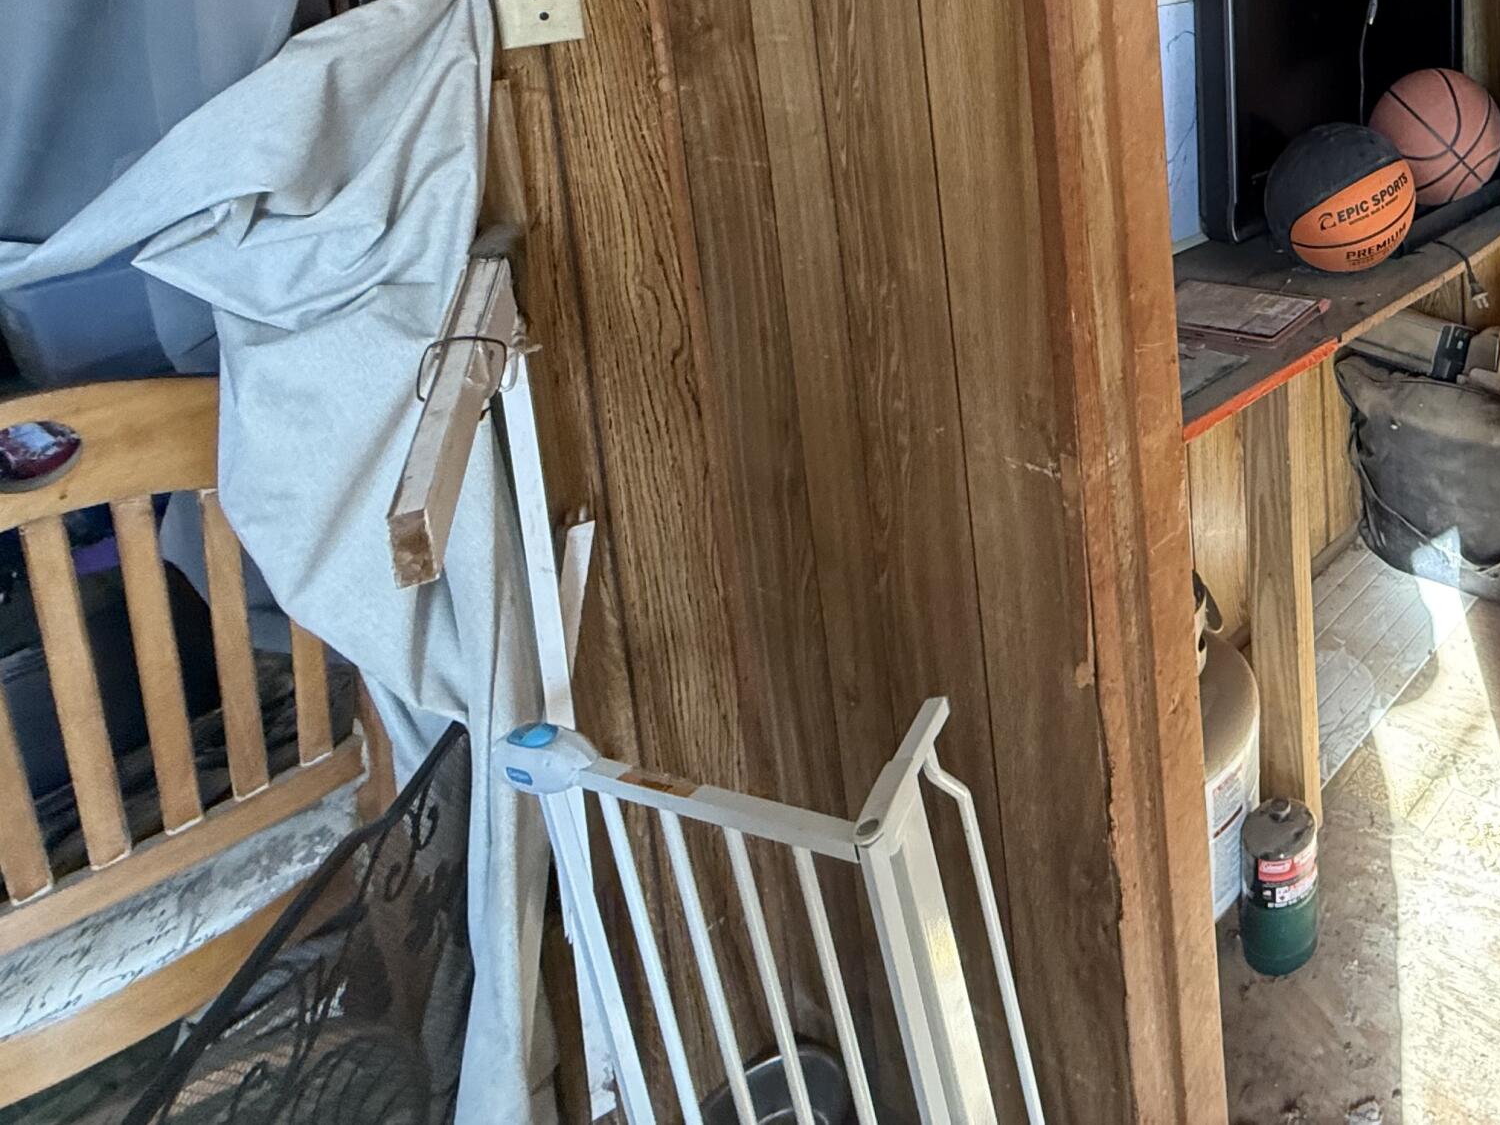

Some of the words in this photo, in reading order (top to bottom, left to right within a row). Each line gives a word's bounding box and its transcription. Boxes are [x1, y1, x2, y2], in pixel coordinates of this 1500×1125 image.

[1336, 200, 1369, 223] EPIC
[1371, 172, 1408, 207] SPORTS
[1346, 221, 1406, 260] PREMIUM
